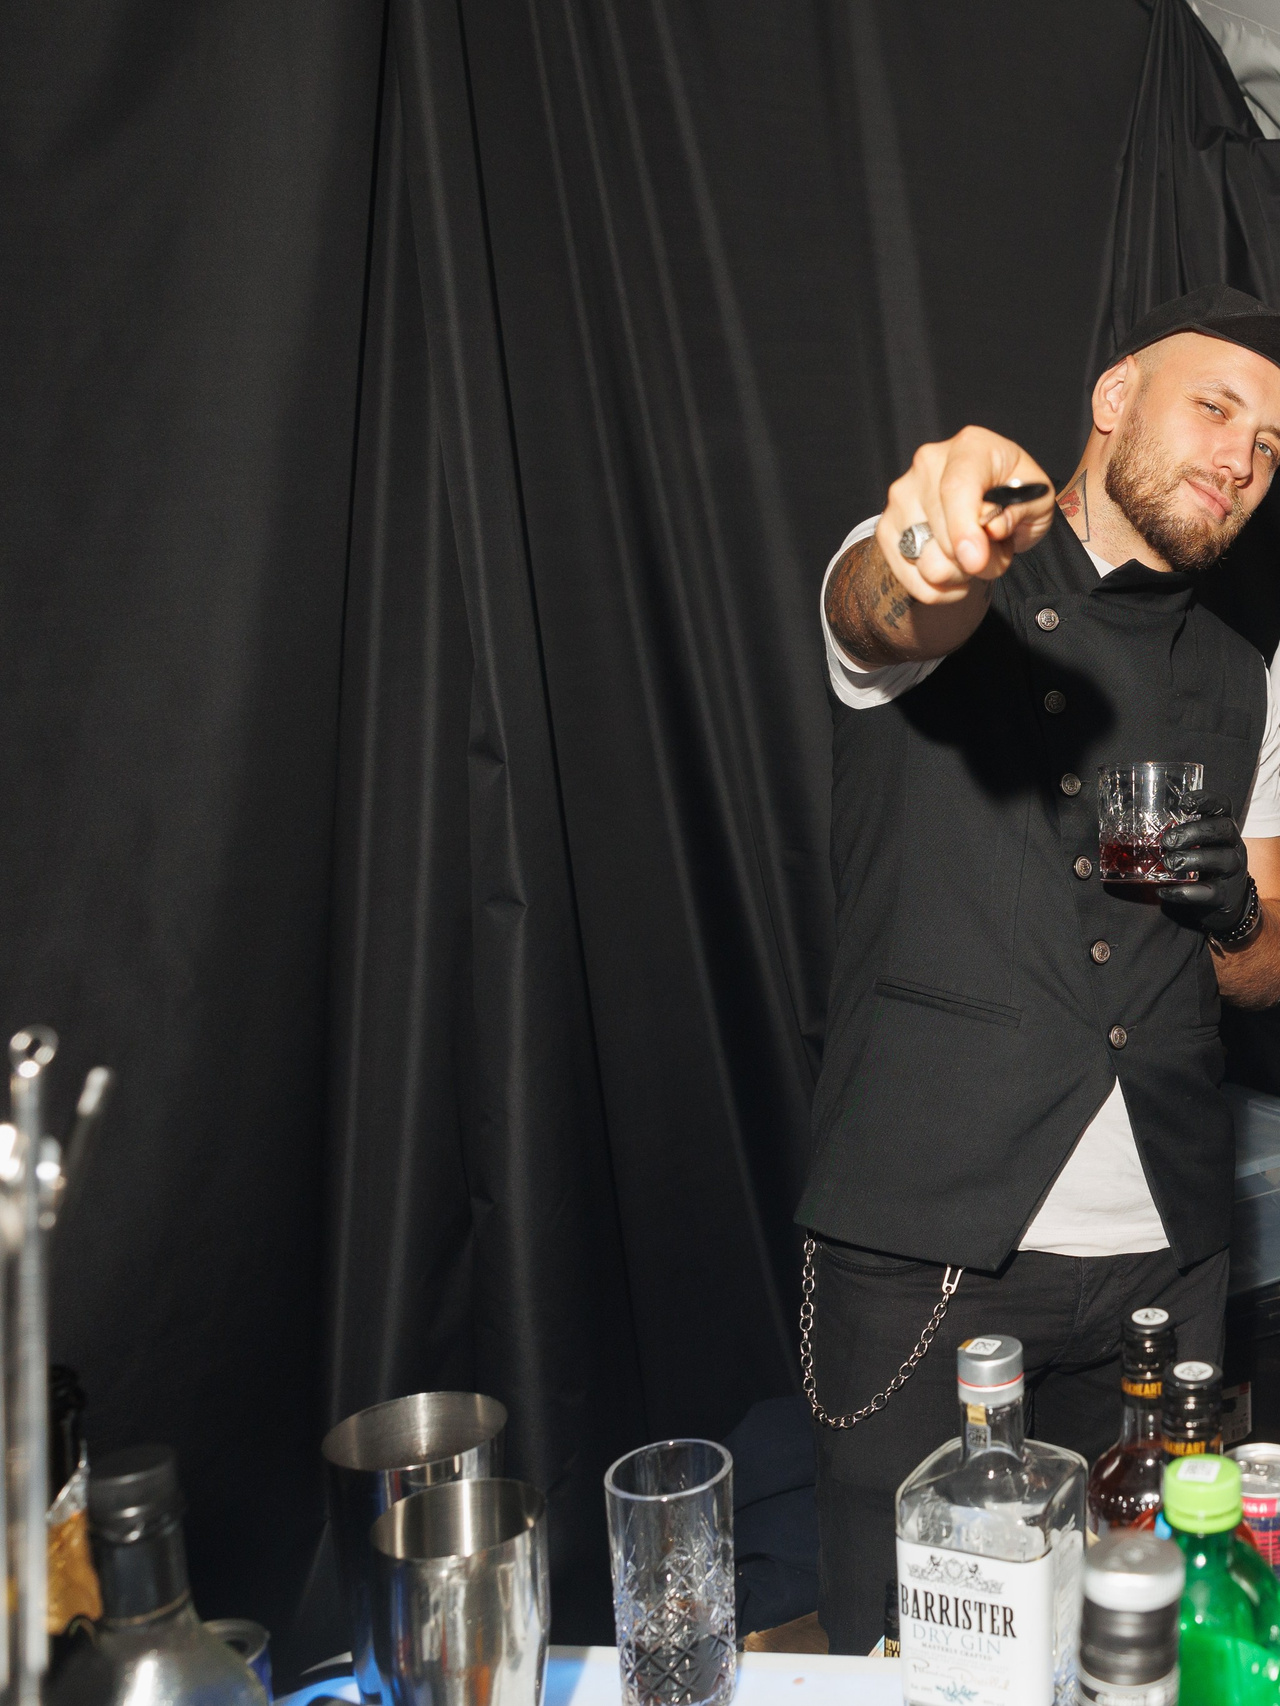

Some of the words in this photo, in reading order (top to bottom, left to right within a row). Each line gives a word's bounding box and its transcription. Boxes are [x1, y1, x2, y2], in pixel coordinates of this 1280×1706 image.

[900, 1582, 1018, 1639] BARRISTER
[913, 1623, 953, 1646] DRY
[961, 1634, 1001, 1655] GIN
